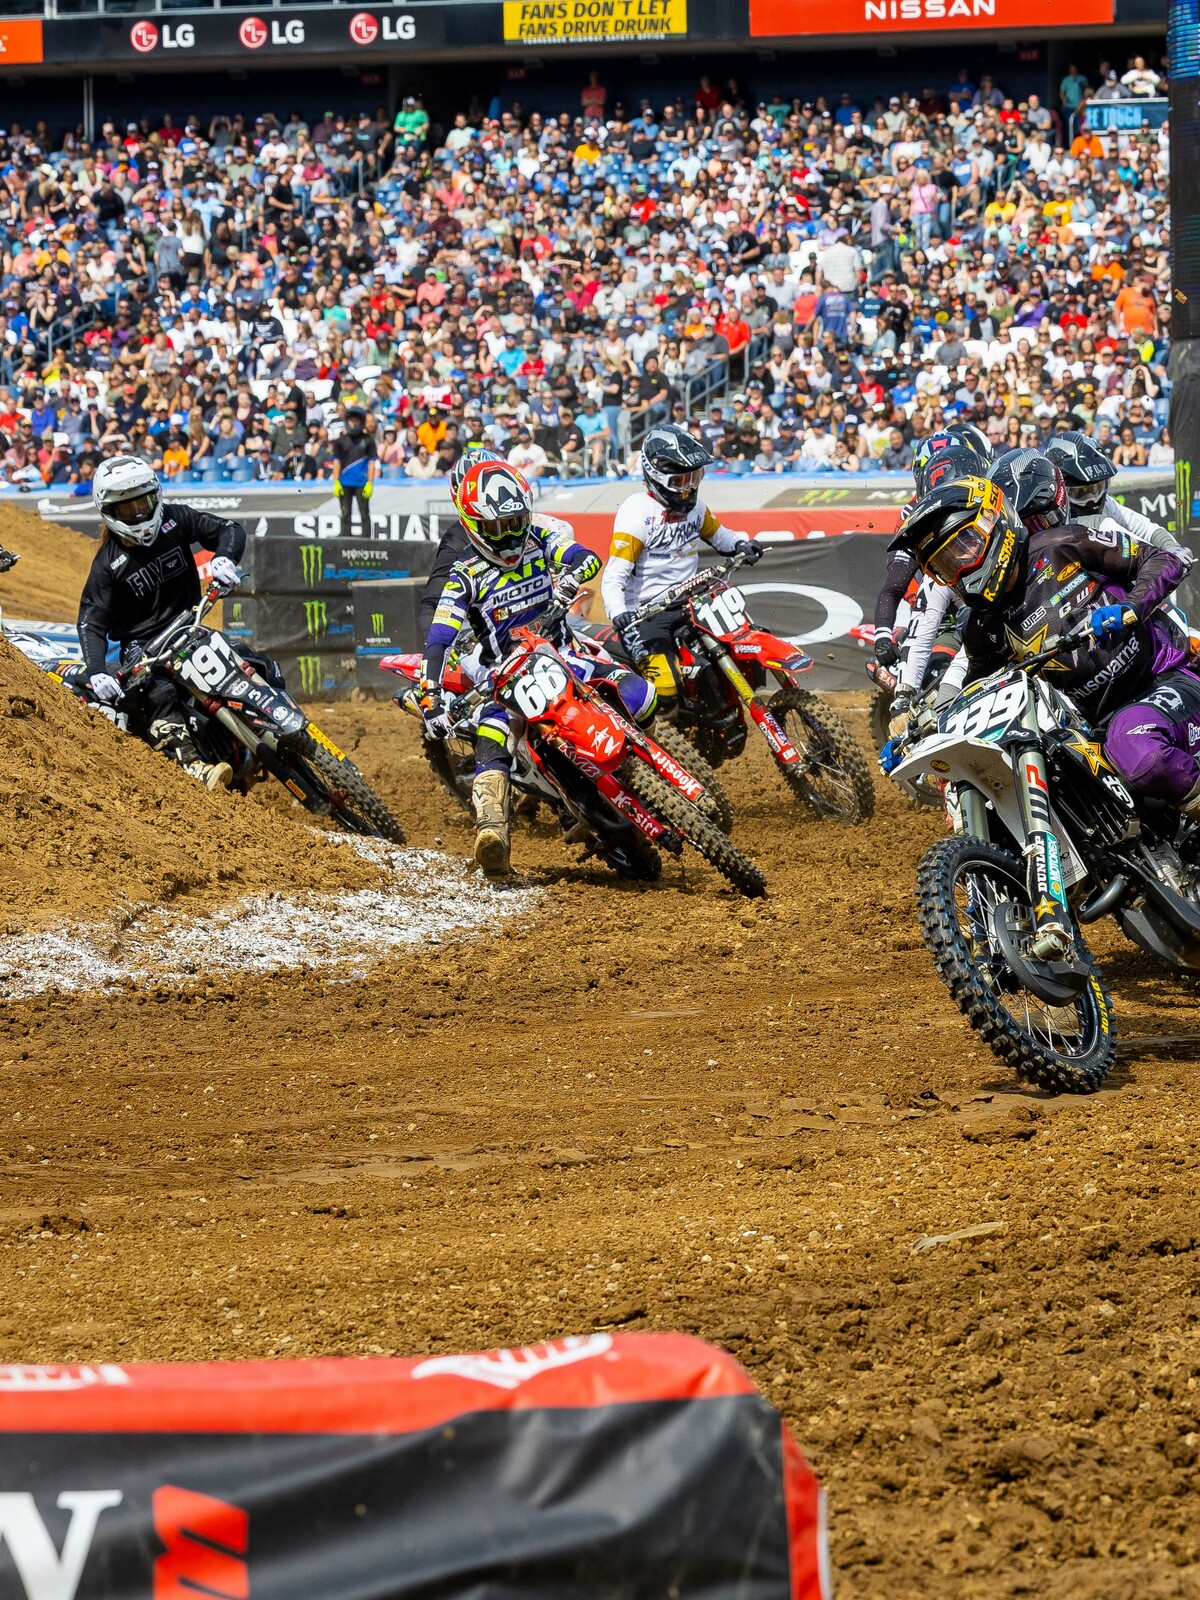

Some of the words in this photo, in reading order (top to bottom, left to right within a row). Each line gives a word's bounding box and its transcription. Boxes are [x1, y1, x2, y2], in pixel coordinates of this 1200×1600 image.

[521, 3, 568, 20] FANS
[574, 0, 634, 18] DON'T
[637, 0, 671, 15] LET
[865, 0, 996, 20] NISSAN
[162, 24, 195, 48] LG
[272, 19, 305, 44] LG
[382, 16, 416, 40] LG
[518, 22, 558, 36] FANS
[563, 20, 609, 35] DRIVE
[614, 17, 671, 33] DRUNK
[1084, 463, 1108, 477] FLY
[341, 549, 389, 561] MONSTER
[126, 555, 166, 598] FLY
[1059, 572, 1089, 599] MOTOREX
[492, 577, 545, 605] MOTO
[696, 586, 746, 637] 119
[1021, 604, 1048, 631] WPS
[180, 631, 235, 694] 191
[1071, 634, 1141, 701] Husqvarna
[514, 653, 568, 719] 66
[650, 750, 702, 797] Hoosier
[1033, 835, 1048, 893] DUNLOP
[1048, 838, 1059, 884] MOTOREX
[1092, 981, 1109, 1036] DUNLOP
